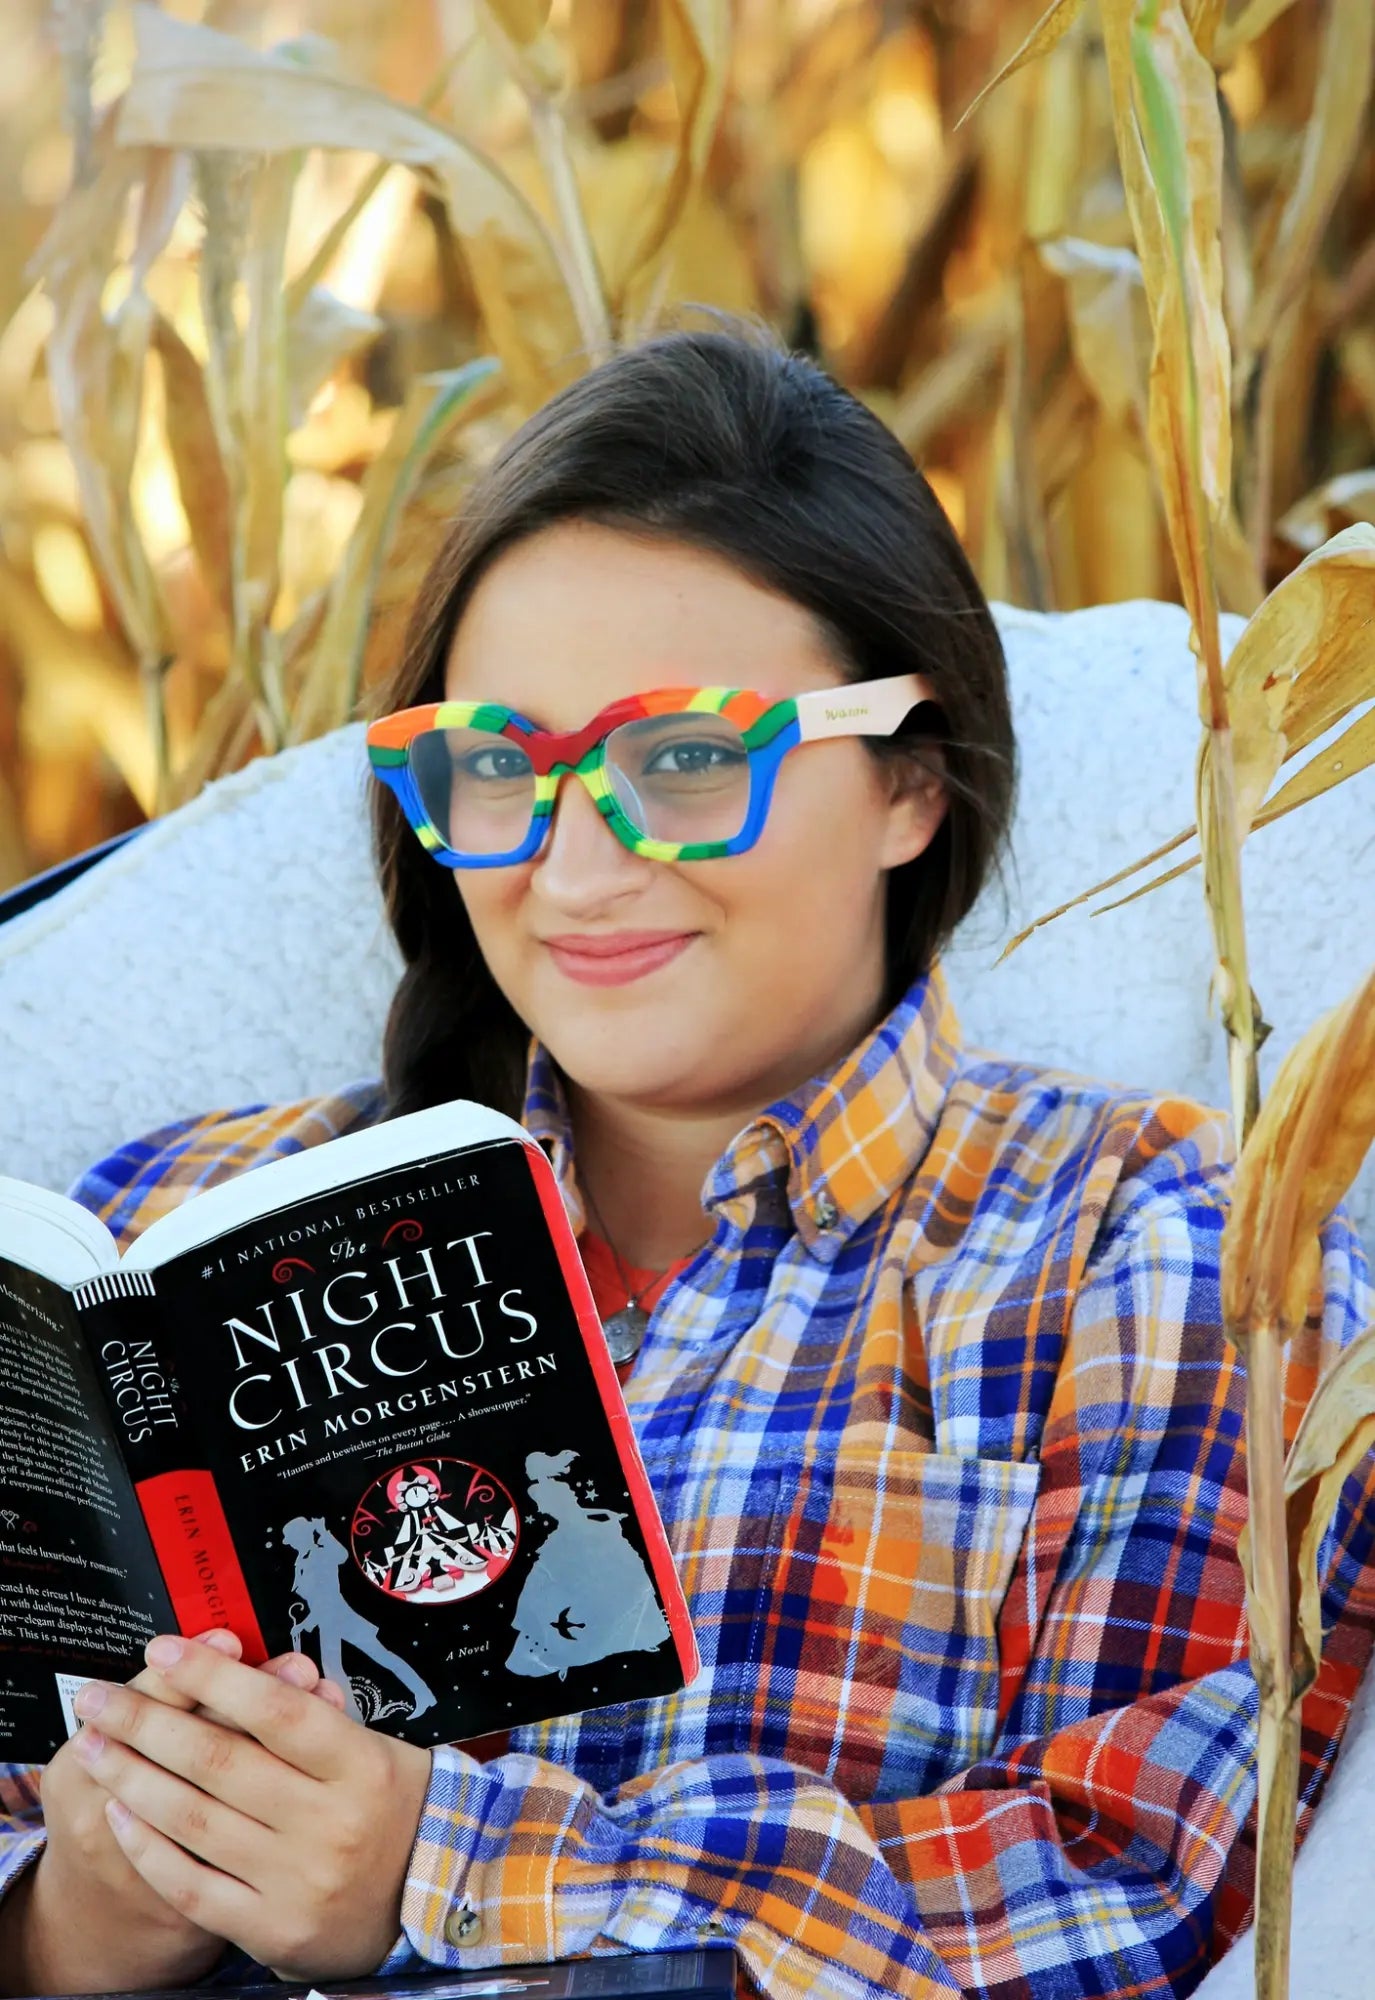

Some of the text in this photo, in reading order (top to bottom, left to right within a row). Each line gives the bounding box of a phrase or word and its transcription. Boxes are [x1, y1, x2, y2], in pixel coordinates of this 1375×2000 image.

[201, 1173, 481, 1280] #1 NATIONAL BESTSELLER
[330, 1236, 367, 1263] The
[222, 1231, 493, 1371] NIGHT
[229, 1289, 538, 1430] CIRCUS
[101, 1340, 152, 1444] CIRCUS
[129, 1339, 178, 1428] NIGHT
[239, 1352, 558, 1473] ERIN MORGENSTERN
[315, 1453, 331, 1466] and
[332, 1439, 377, 1459] bewitches
[378, 1435, 391, 1445] on
[391, 1426, 417, 1441] every
[458, 1412, 467, 1421] A
[395, 1438, 424, 1453] Boston
[426, 1430, 452, 1443] Globe
[9, 1480, 45, 1492] everyone
[45, 1485, 65, 1498] from
[175, 1494, 200, 1540] ERIN
[17, 1542, 38, 1556] feels
[39, 1546, 88, 1568] luxuriously
[9, 1598, 31, 1609] with
[32, 1599, 65, 1616] dueling
[25, 1584, 40, 1596] the
[41, 1588, 69, 1601] circus
[75, 1592, 97, 1607] have
[98, 1597, 128, 1615] always
[16, 1626, 40, 1640] This
[41, 1631, 50, 1641] is
[51, 1635, 58, 1643] a
[59, 1636, 105, 1651] marvelous
[57, 1617, 93, 1635] displays
[94, 1625, 104, 1636] of
[103, 1626, 133, 1644] beauty
[445, 1640, 490, 1662] A Novel
